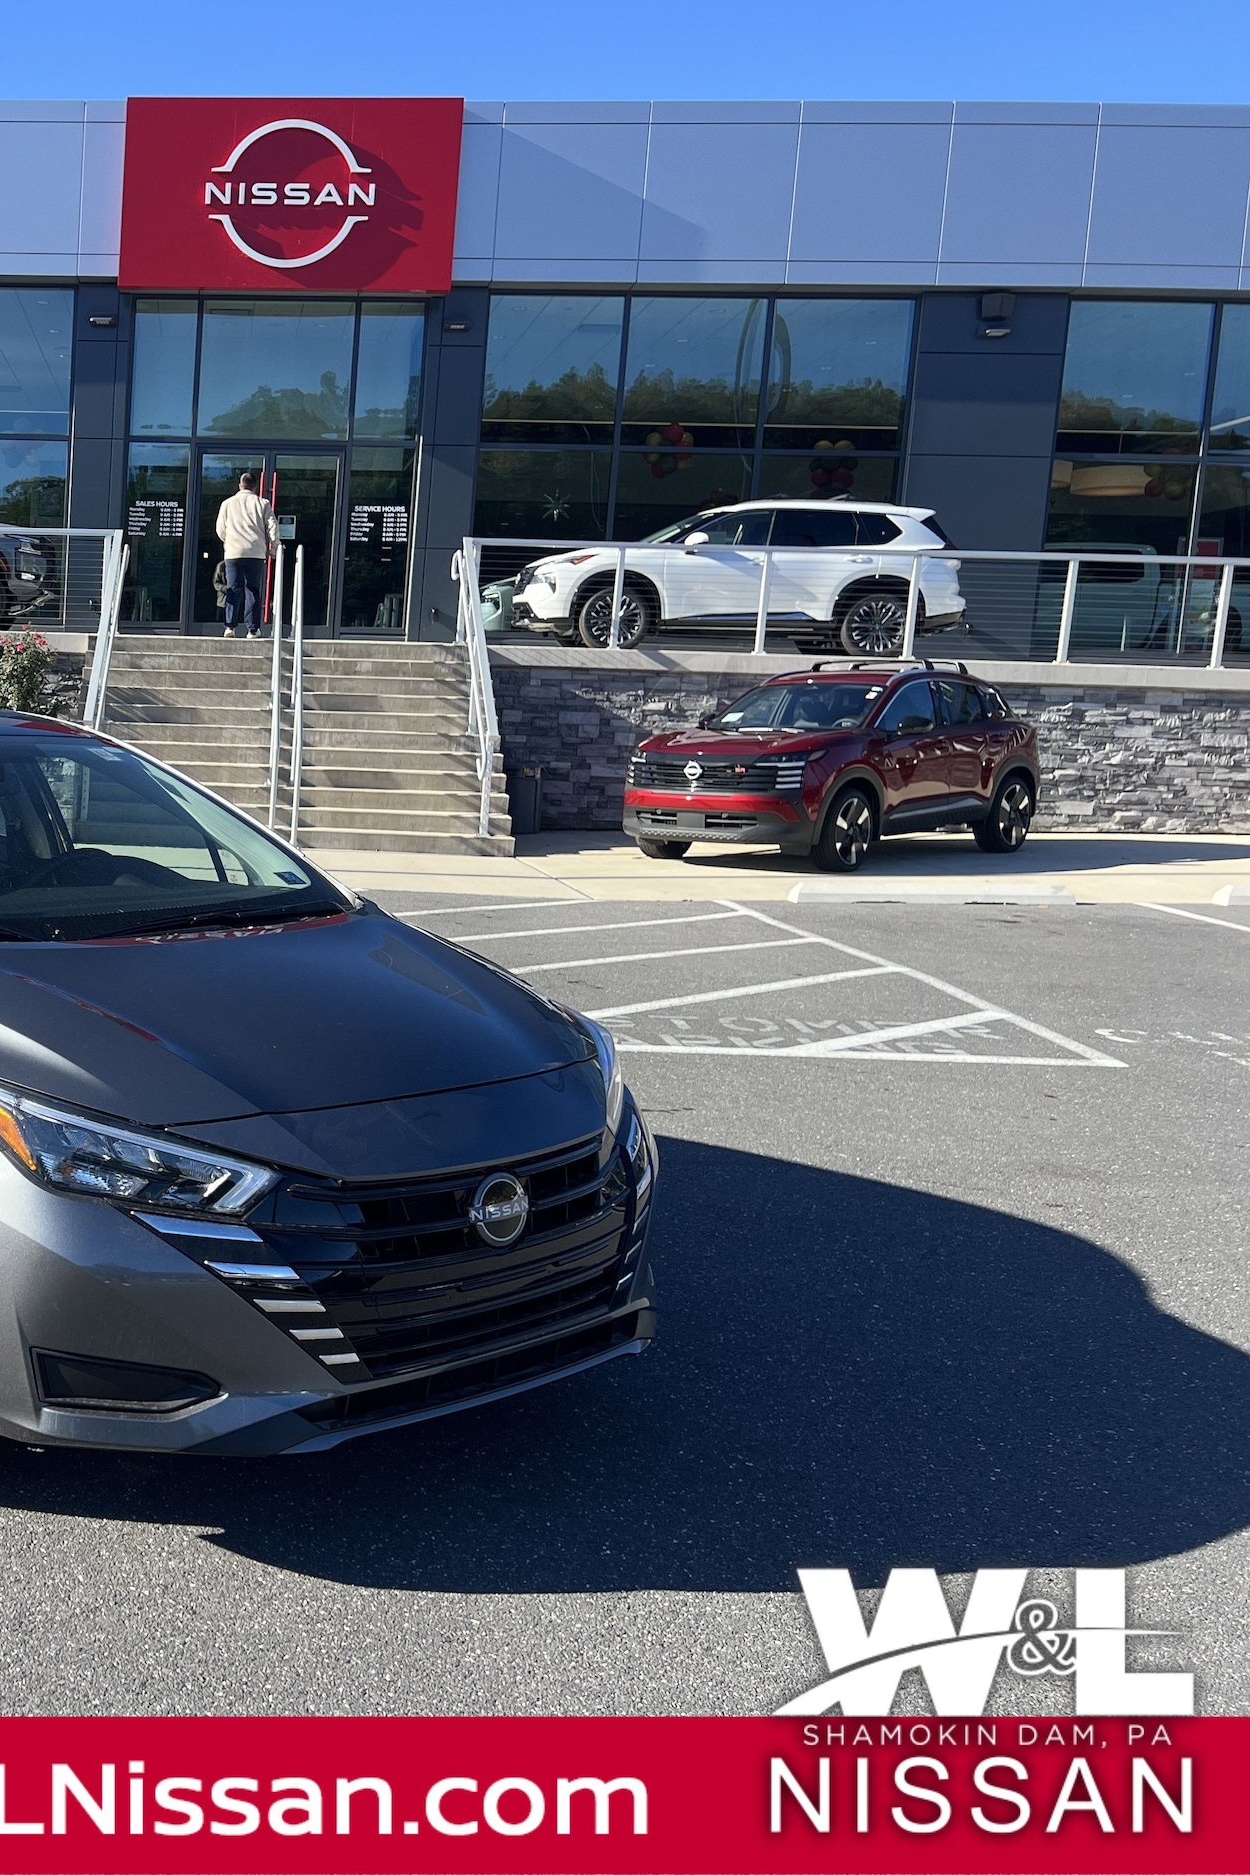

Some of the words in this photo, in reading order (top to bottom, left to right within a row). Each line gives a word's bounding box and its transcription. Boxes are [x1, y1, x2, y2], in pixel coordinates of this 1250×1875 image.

[204, 182, 376, 207] NISSAN
[596, 1013, 1007, 1041] STOMER
[470, 1198, 529, 1221] NISSAN
